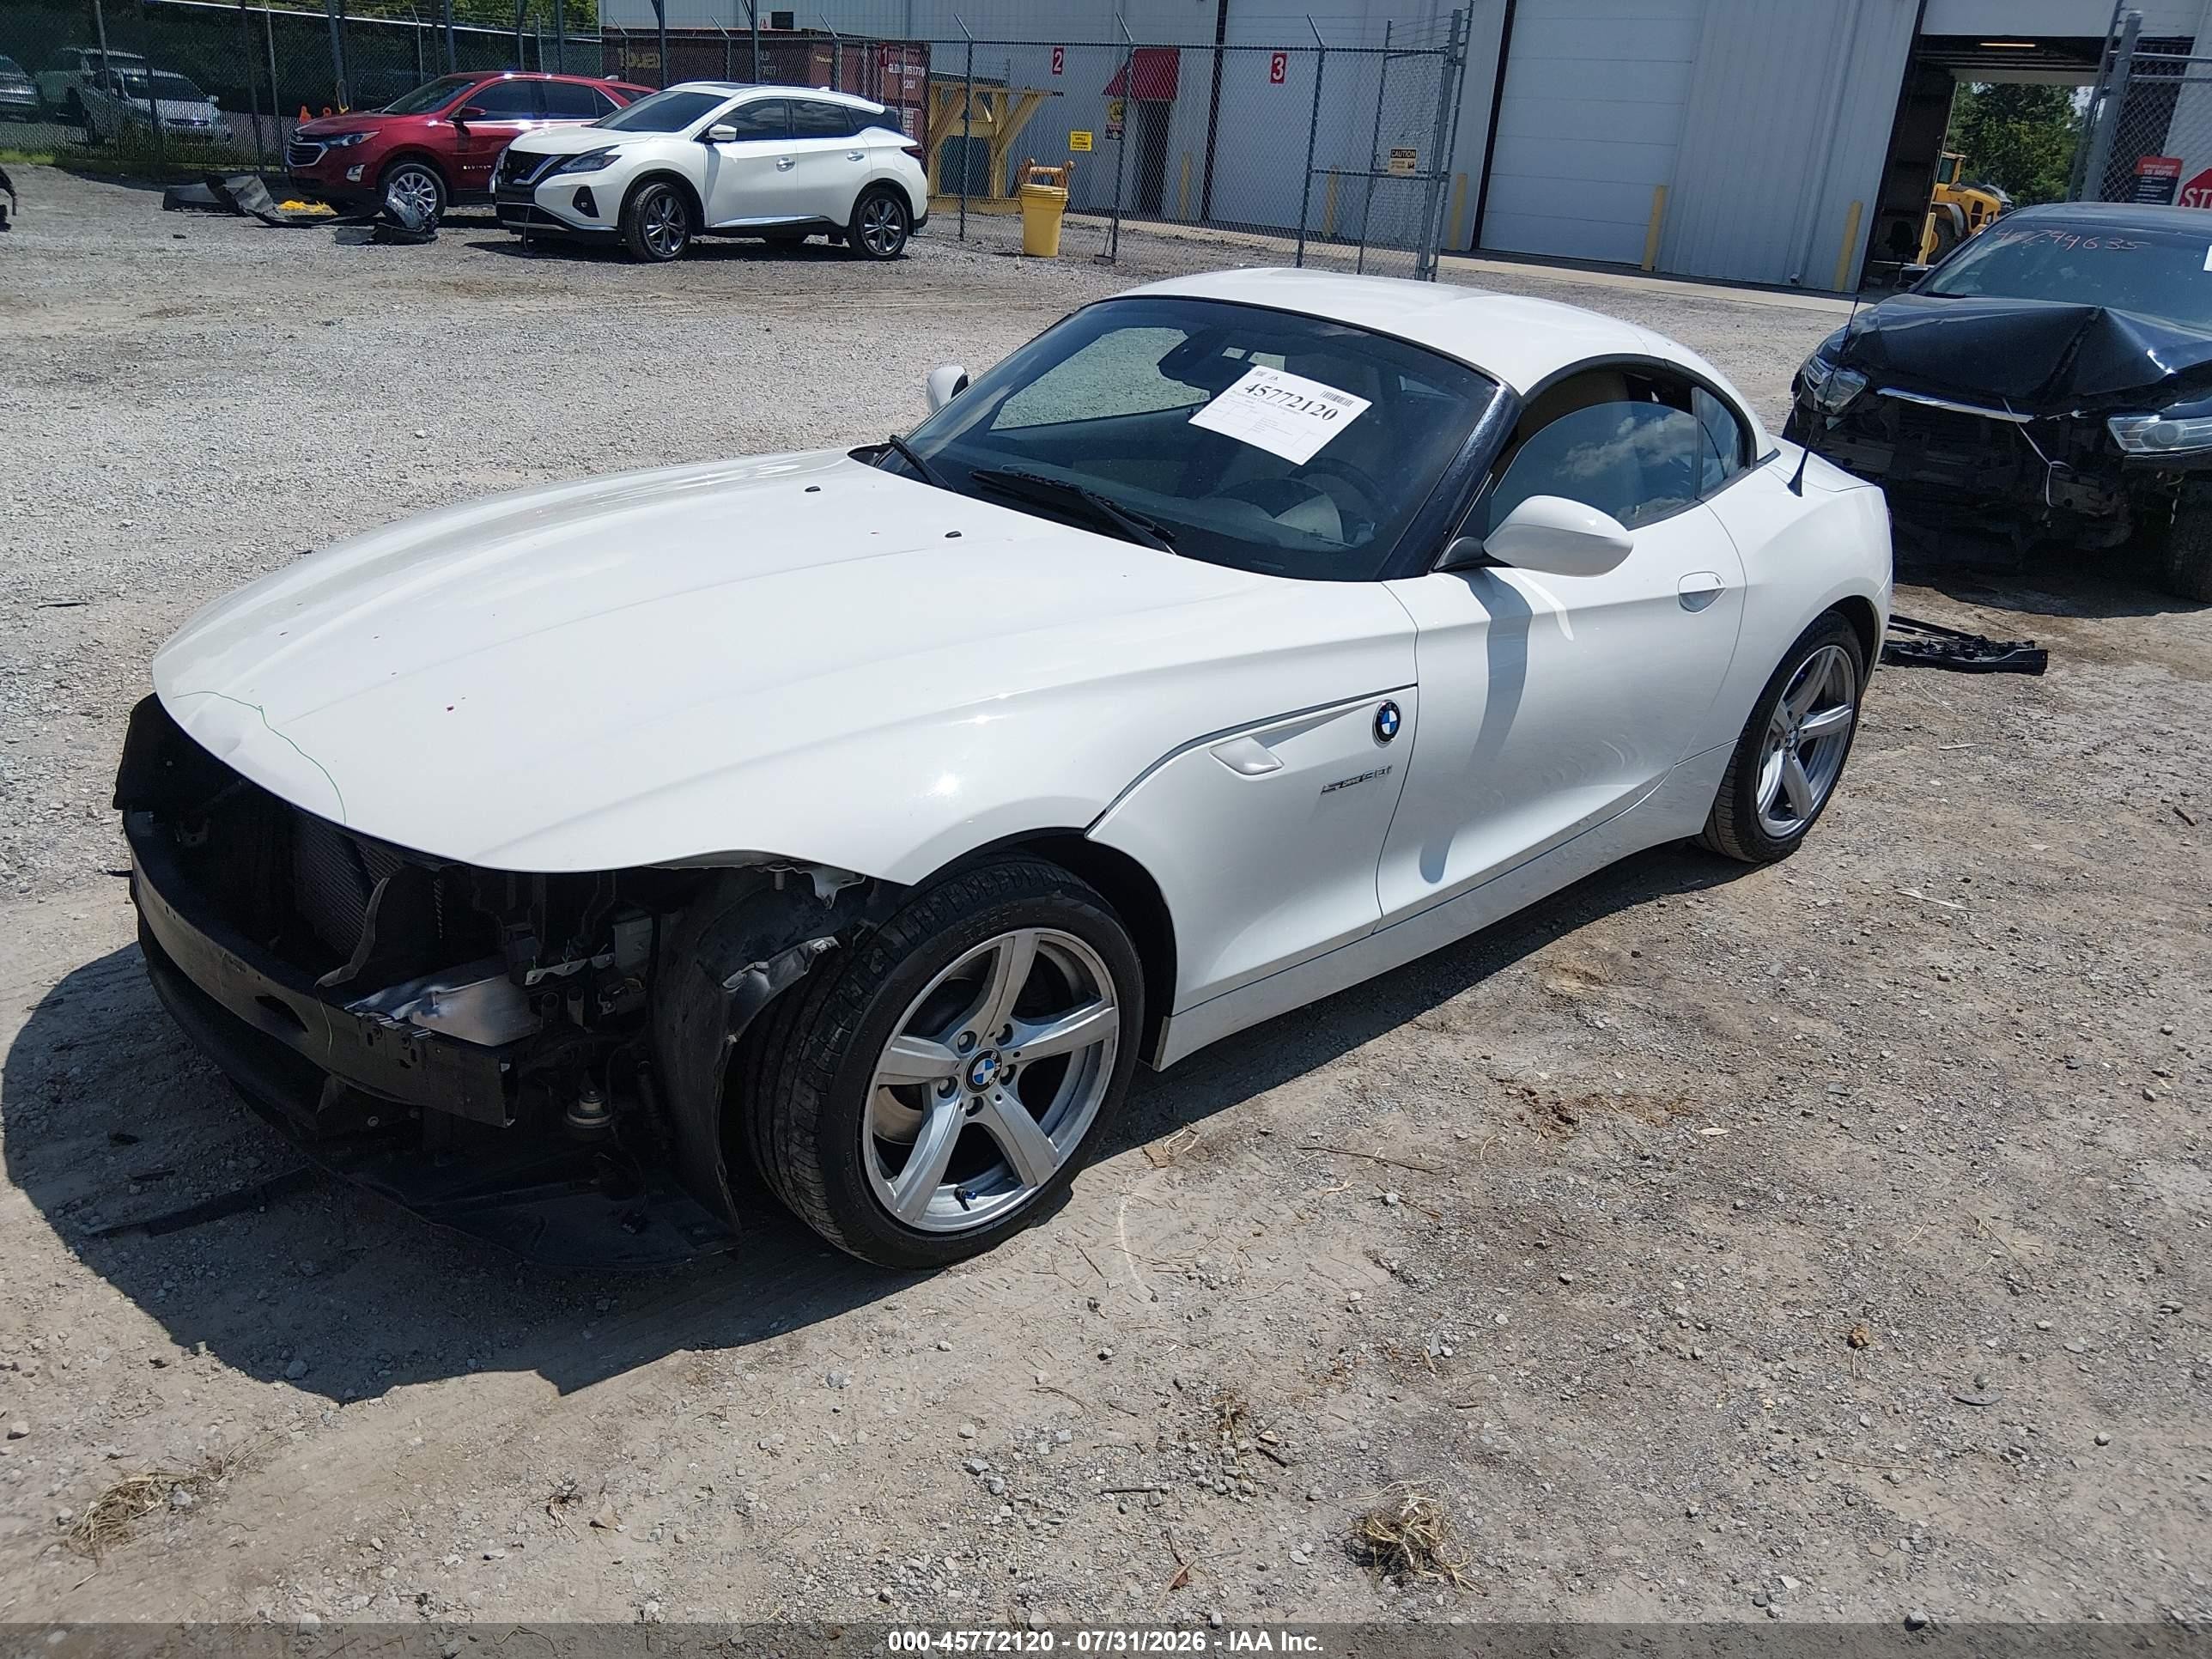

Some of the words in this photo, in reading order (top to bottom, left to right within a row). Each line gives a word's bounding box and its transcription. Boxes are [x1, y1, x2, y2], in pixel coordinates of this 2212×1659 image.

[882, 46, 888, 65] 1
[1053, 51, 1063, 71] 2
[1273, 57, 1284, 80] 3
[2184, 187, 2212, 208] ST
[1245, 383, 1339, 421] 45772120
